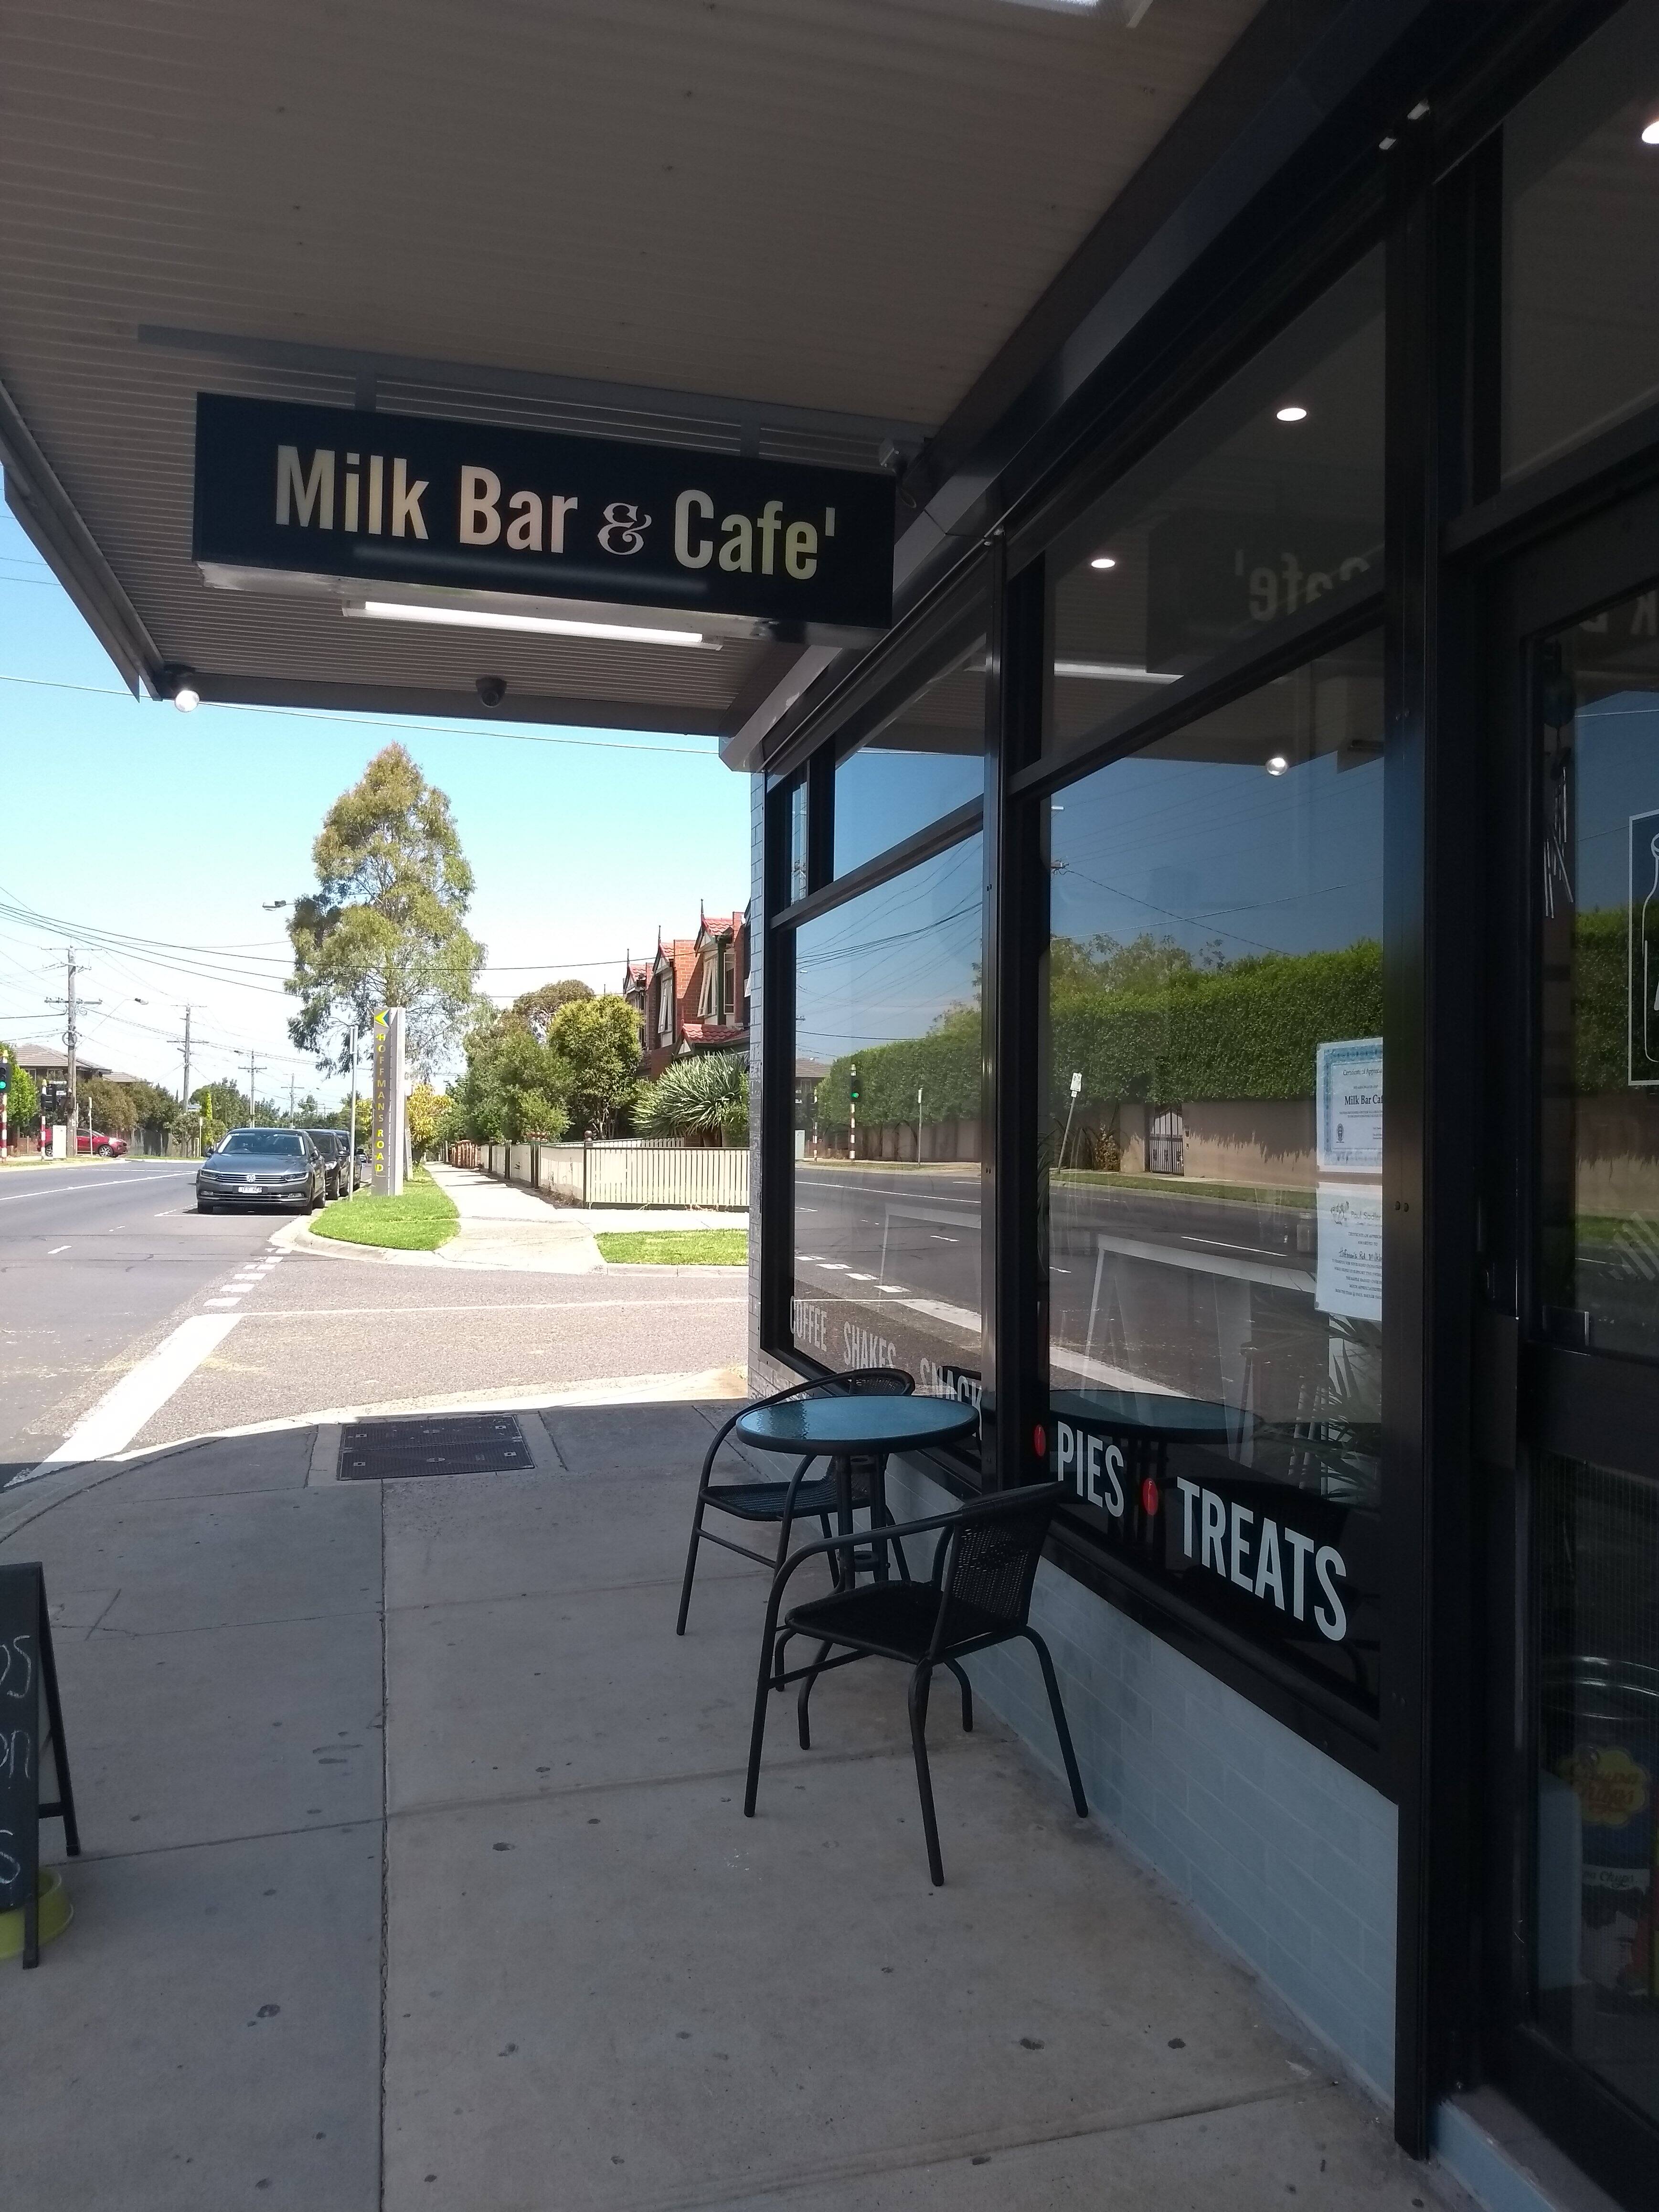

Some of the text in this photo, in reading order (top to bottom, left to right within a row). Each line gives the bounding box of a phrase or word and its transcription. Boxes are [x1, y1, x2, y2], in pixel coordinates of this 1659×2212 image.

[275, 445, 430, 540] Milk
[459, 466, 578, 553] Bar
[597, 502, 652, 555] &
[375, 1033, 386, 1172] HOFFMANS ROAD
[1344, 1095, 1359, 1105] Milk
[1361, 1095, 1371, 1104] Bar
[1351, 1211, 1361, 1219] Paul
[790, 1296, 827, 1351] COFFEE
[843, 1321, 896, 1368] SHAKES
[1058, 1421, 1124, 1517] PIES
[1177, 1477, 1347, 1641] TREATS
